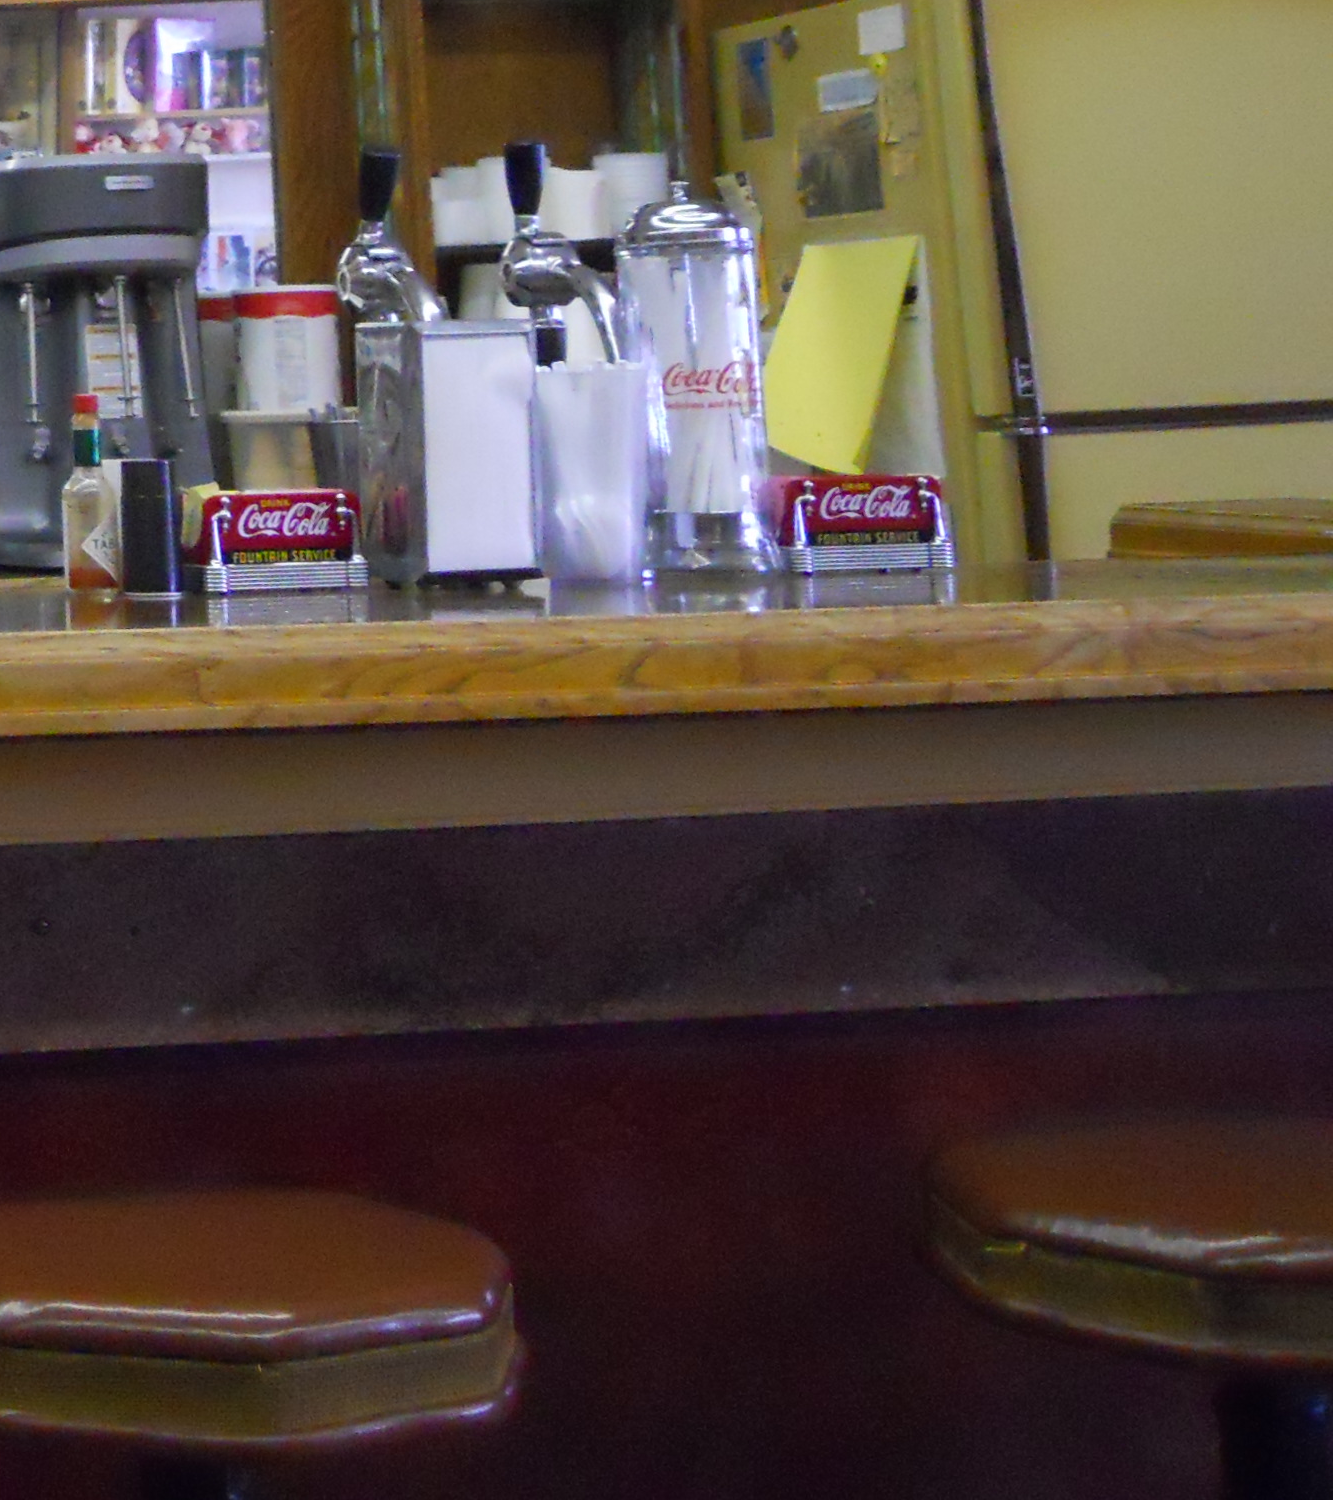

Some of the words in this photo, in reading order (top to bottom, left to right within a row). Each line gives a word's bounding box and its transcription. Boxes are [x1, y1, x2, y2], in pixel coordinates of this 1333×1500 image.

[237, 501, 331, 538] Coca-Cola
[819, 484, 912, 520] Coca-Cola
[233, 550, 289, 564] FOUNTAIN
[292, 549, 336, 563] SERVICE
